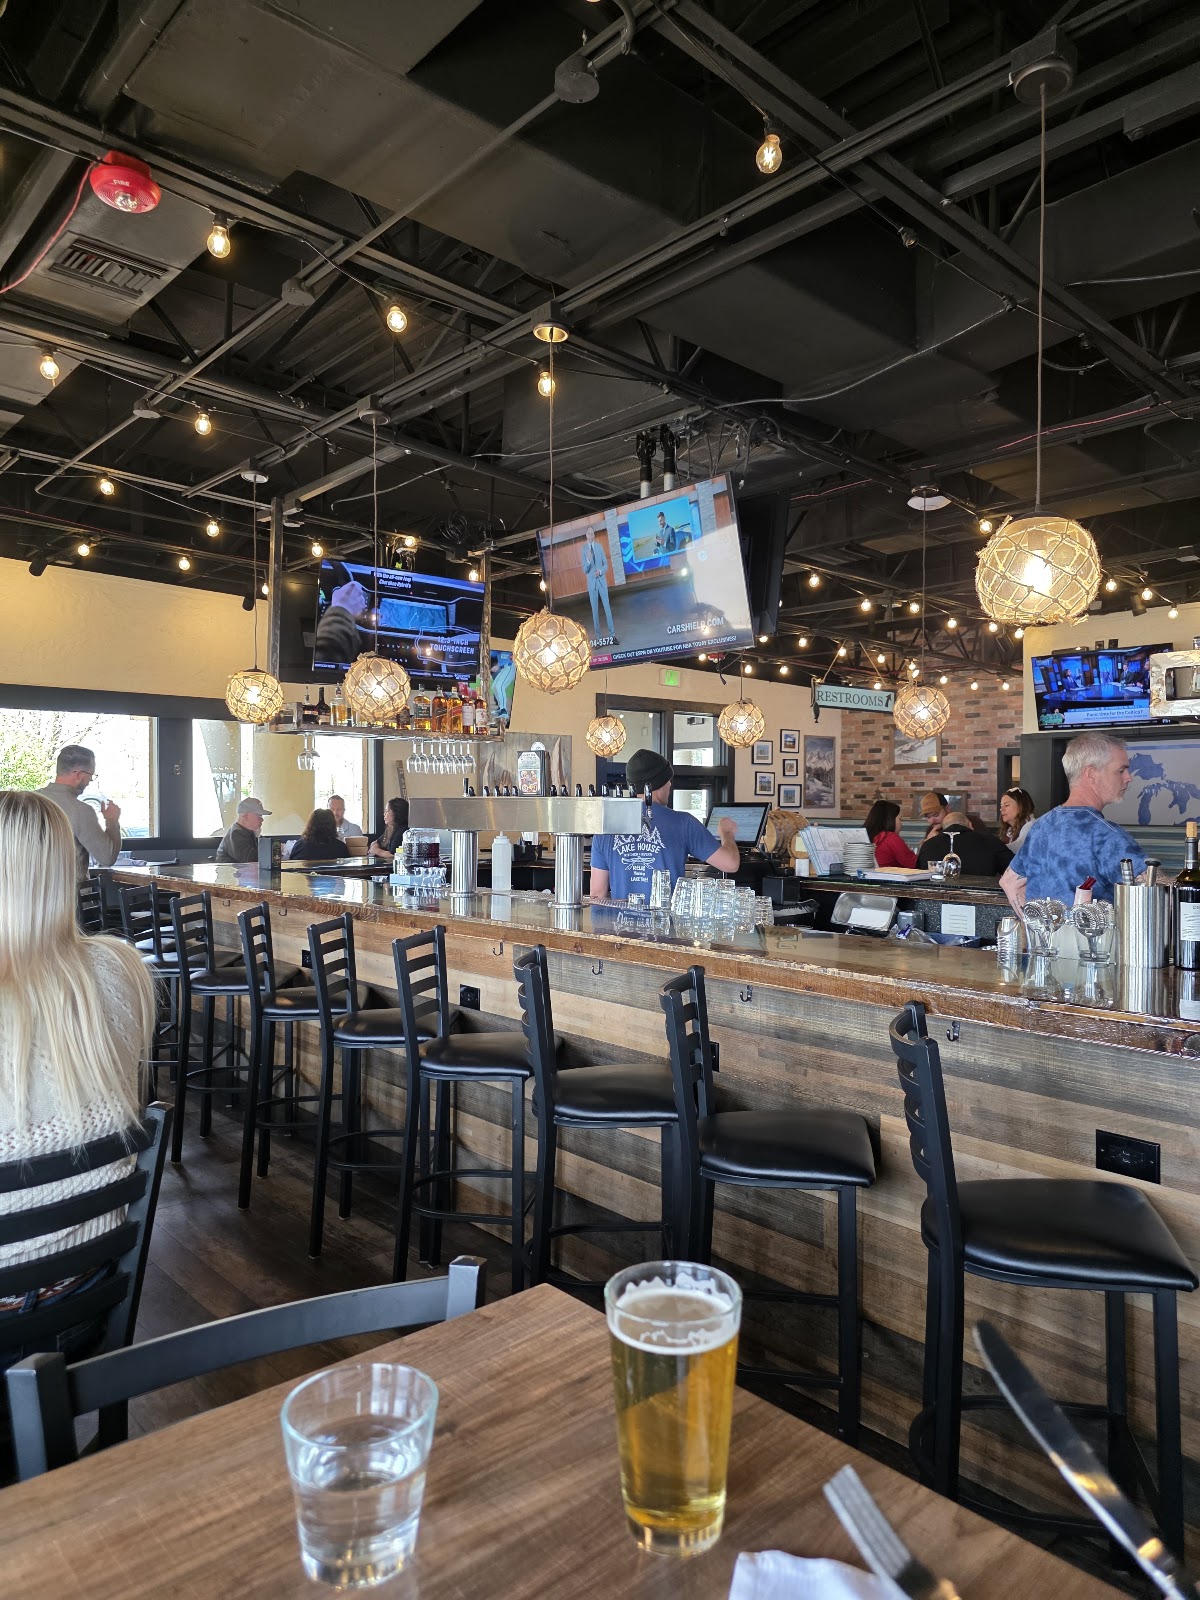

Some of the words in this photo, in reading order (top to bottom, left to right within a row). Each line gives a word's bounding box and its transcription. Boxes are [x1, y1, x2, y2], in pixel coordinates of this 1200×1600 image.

[113, 179, 130, 187] FIRE
[438, 636, 469, 646] 12.3-INCH
[430, 643, 475, 655] TOUCHSCREEN
[816, 690, 884, 707] RESTROOMS
[617, 843, 635, 855] LAKE
[637, 842, 661, 853] HOUSE
